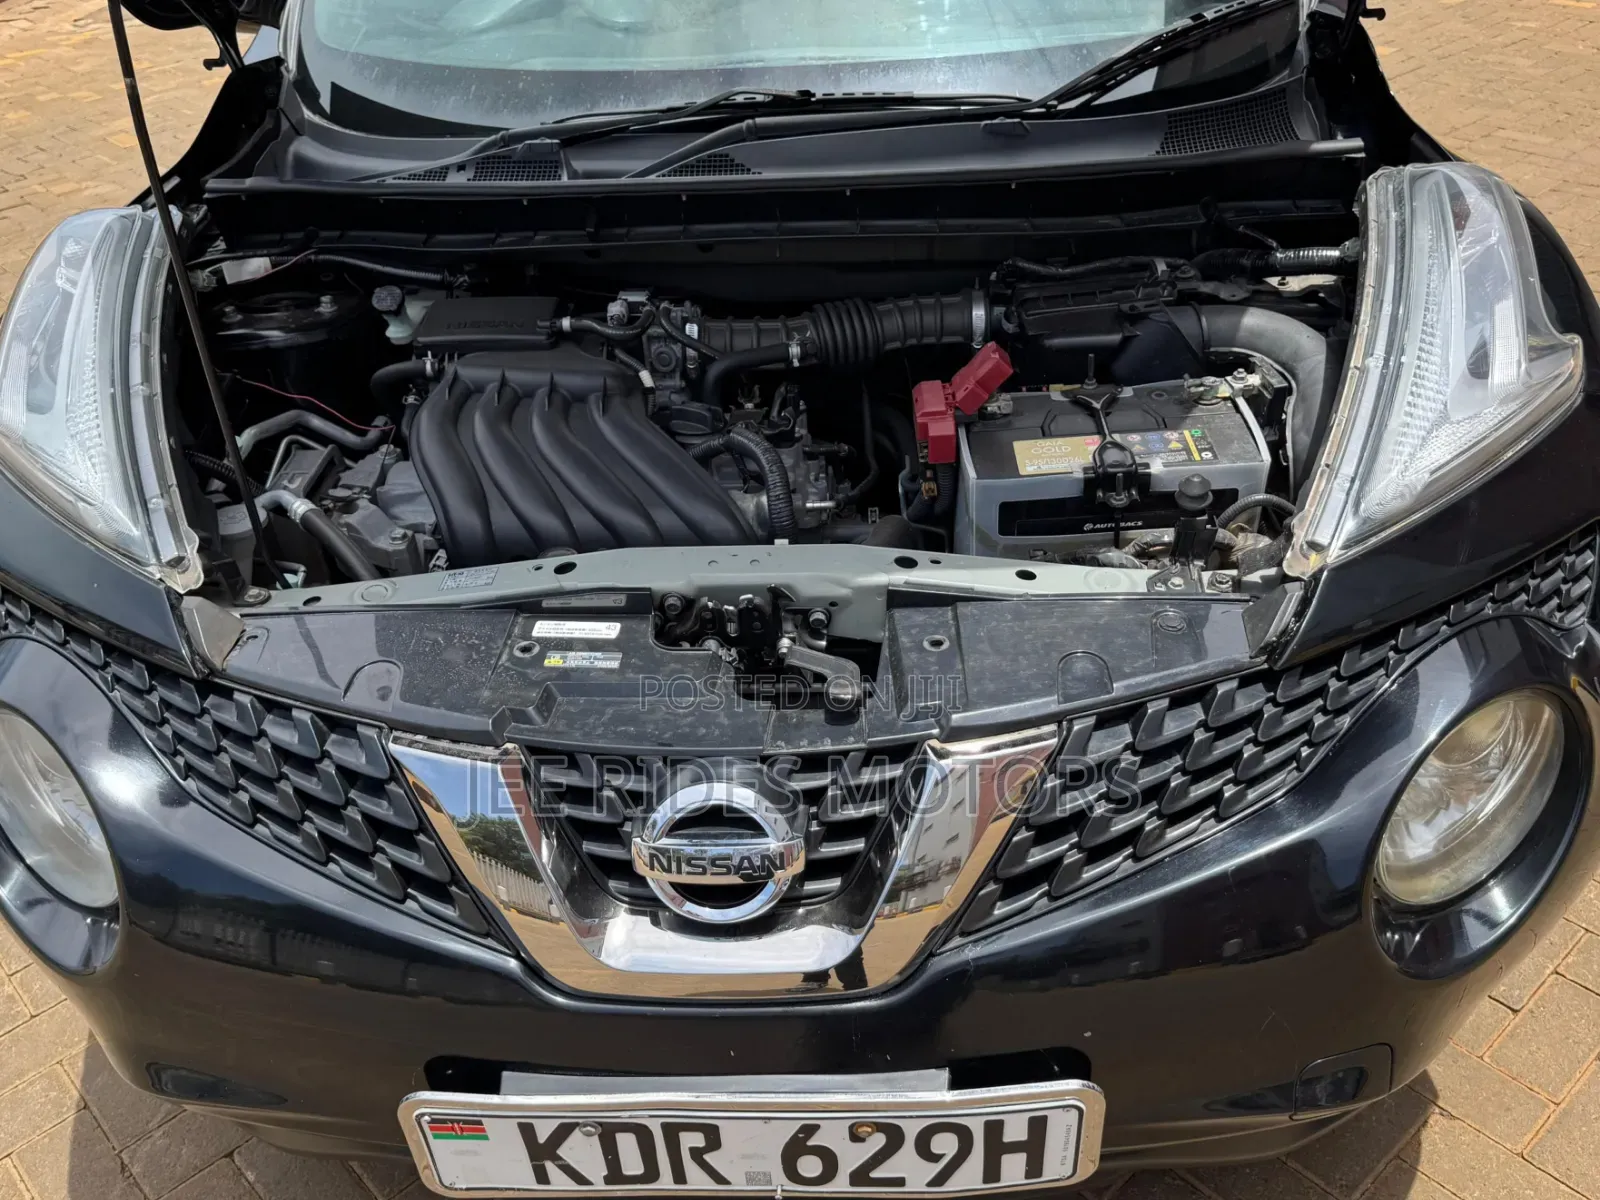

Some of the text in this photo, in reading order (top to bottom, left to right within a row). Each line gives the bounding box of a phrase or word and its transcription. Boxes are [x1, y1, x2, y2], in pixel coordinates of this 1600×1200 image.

[1031, 445, 1072, 454] GOLD
[1094, 521, 1144, 529] AUTBACS
[649, 851, 785, 877] NISSAN
[516, 1121, 733, 1186] KDR
[780, 1114, 1048, 1187] 629H
